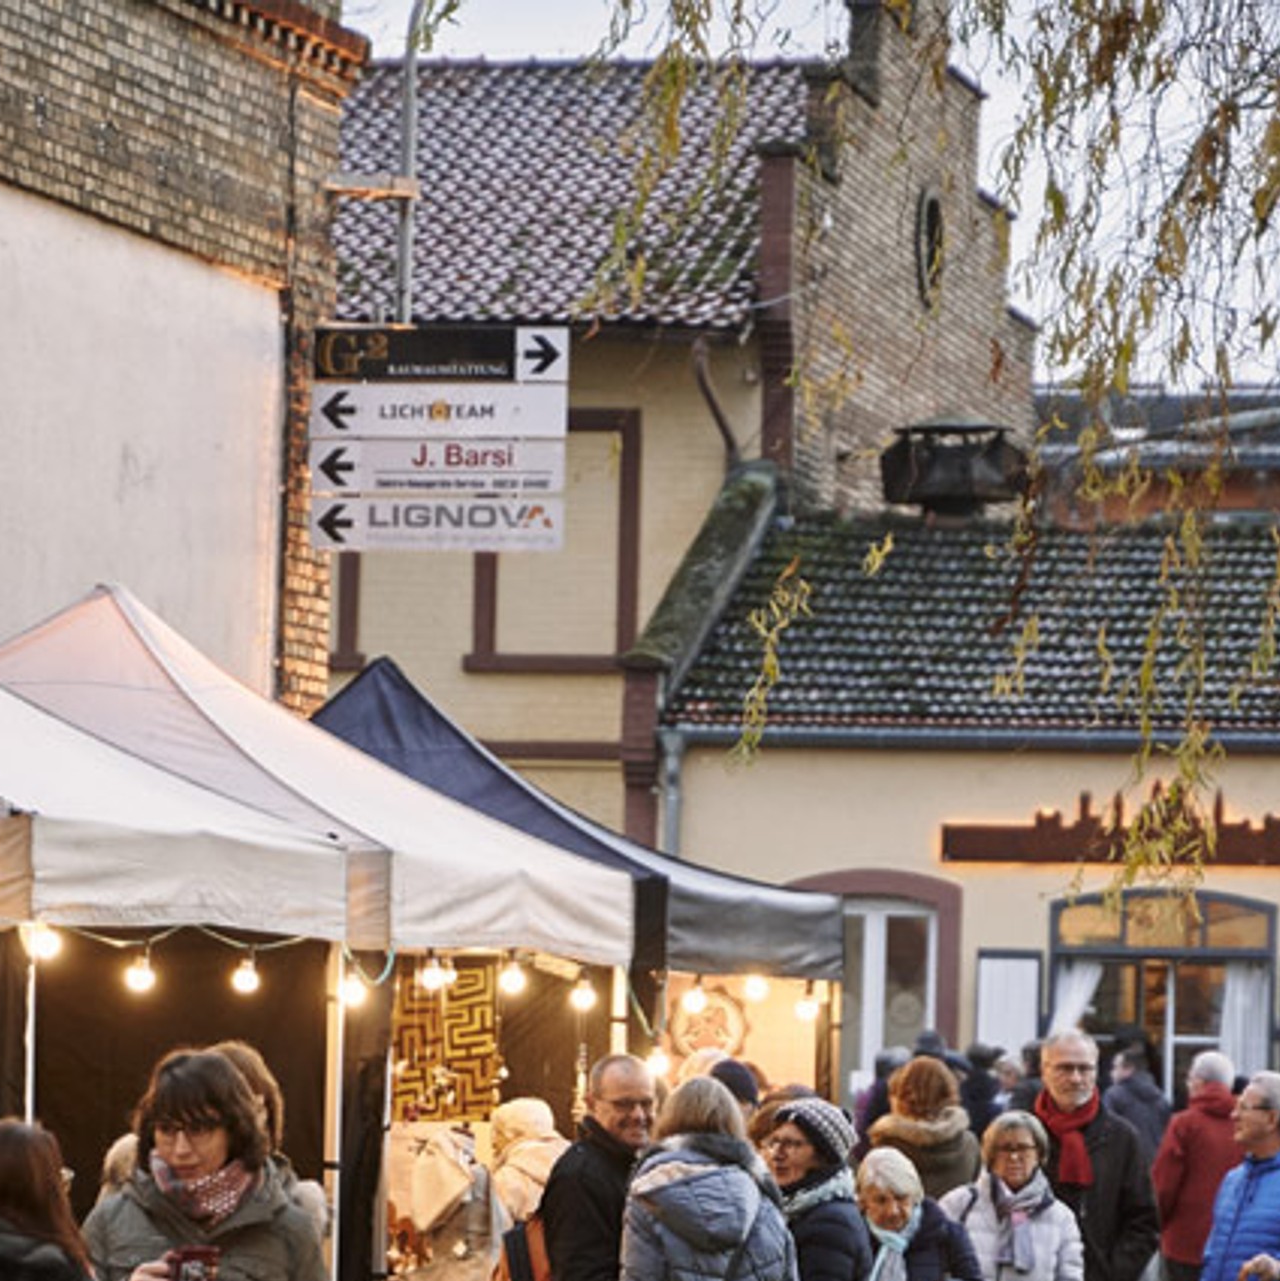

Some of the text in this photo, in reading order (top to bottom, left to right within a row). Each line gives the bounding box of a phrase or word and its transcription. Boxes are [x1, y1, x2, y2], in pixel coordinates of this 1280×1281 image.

[411, 443, 515, 468] J. Barsi
[368, 504, 554, 529] LIGNOVA
